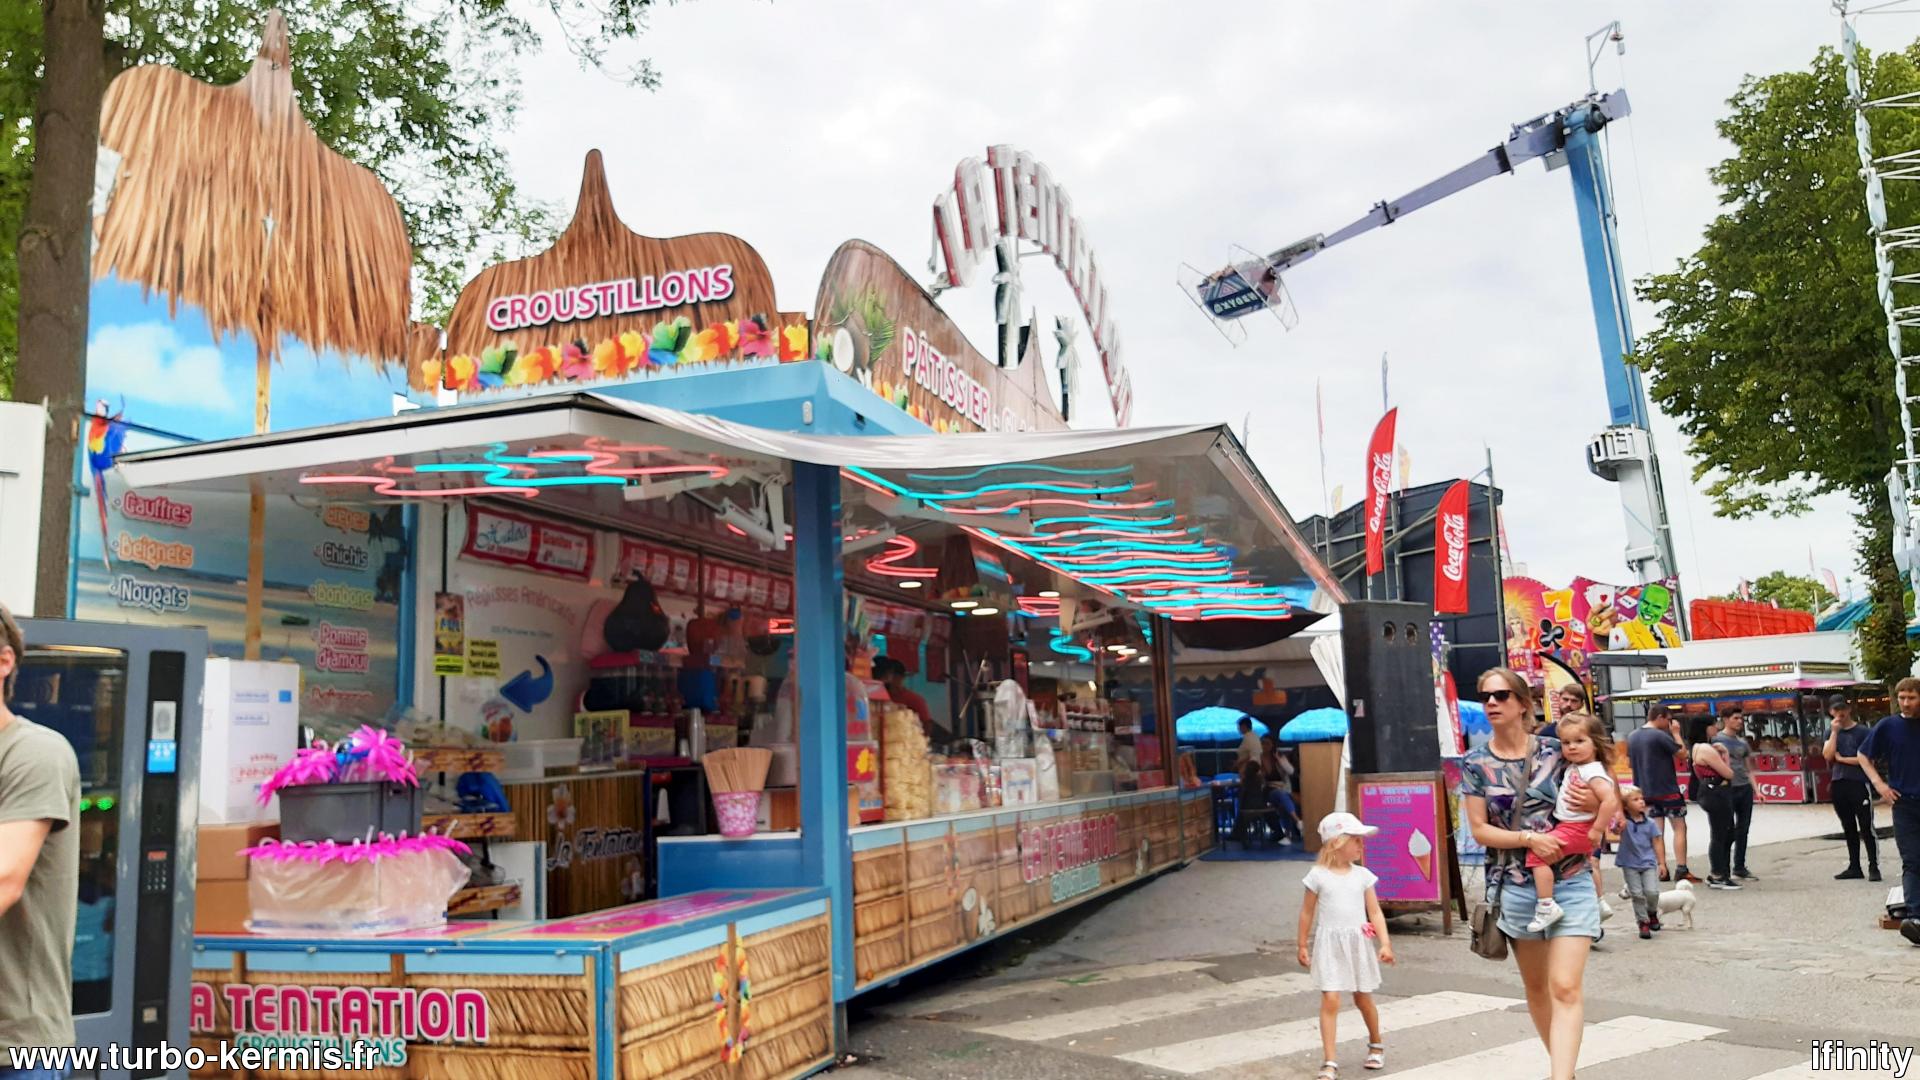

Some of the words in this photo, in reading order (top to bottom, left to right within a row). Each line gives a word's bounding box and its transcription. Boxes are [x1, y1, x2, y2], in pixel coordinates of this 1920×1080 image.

[488, 265, 735, 331] CROUSTILLONS
[1213, 291, 1258, 314] OXYGEN
[903, 327, 992, 431] PÂTISSIER
[124, 491, 192, 527] Gauffres
[1370, 452, 1392, 534] Coca-Cola
[323, 542, 368, 568] Chichis
[1442, 512, 1465, 581] Coca-Cola
[119, 576, 189, 613] Nougats
[320, 623, 368, 648] Pomme
[224, 982, 488, 1043] TENTATION
